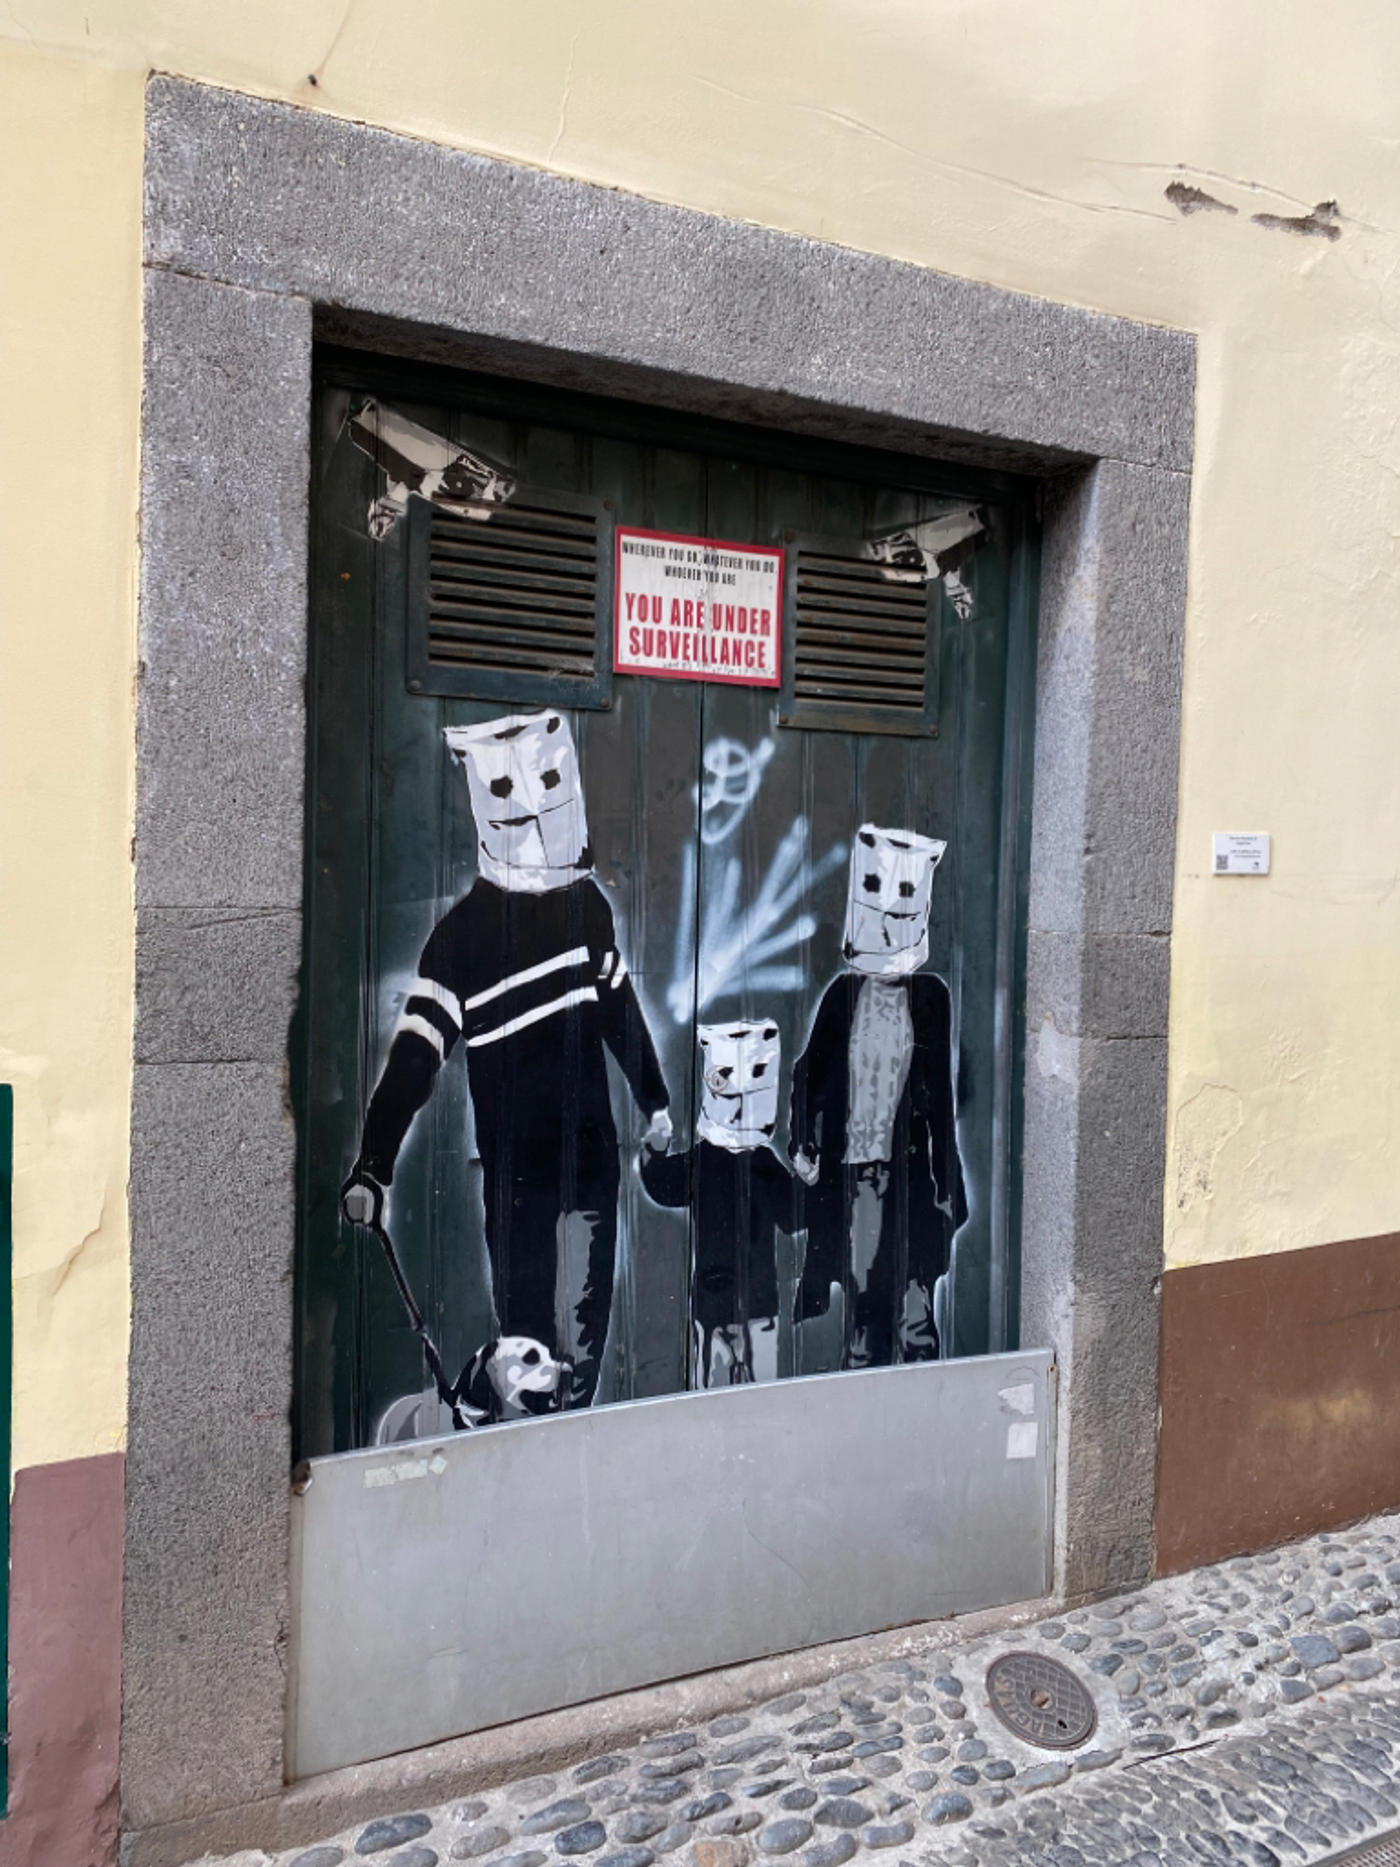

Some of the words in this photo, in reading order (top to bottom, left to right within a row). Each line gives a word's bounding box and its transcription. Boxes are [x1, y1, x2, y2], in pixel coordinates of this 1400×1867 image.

[622, 541, 666, 559] WHEREVER
[669, 548, 684, 561] YOU
[745, 559, 761, 572] YOU
[704, 570, 719, 583] YOU
[722, 573, 737, 586] ARE
[625, 592, 663, 624] YOU
[670, 597, 705, 630] ARE
[712, 602, 771, 636] UNDER
[629, 625, 767, 669] SURVEILLANCE
